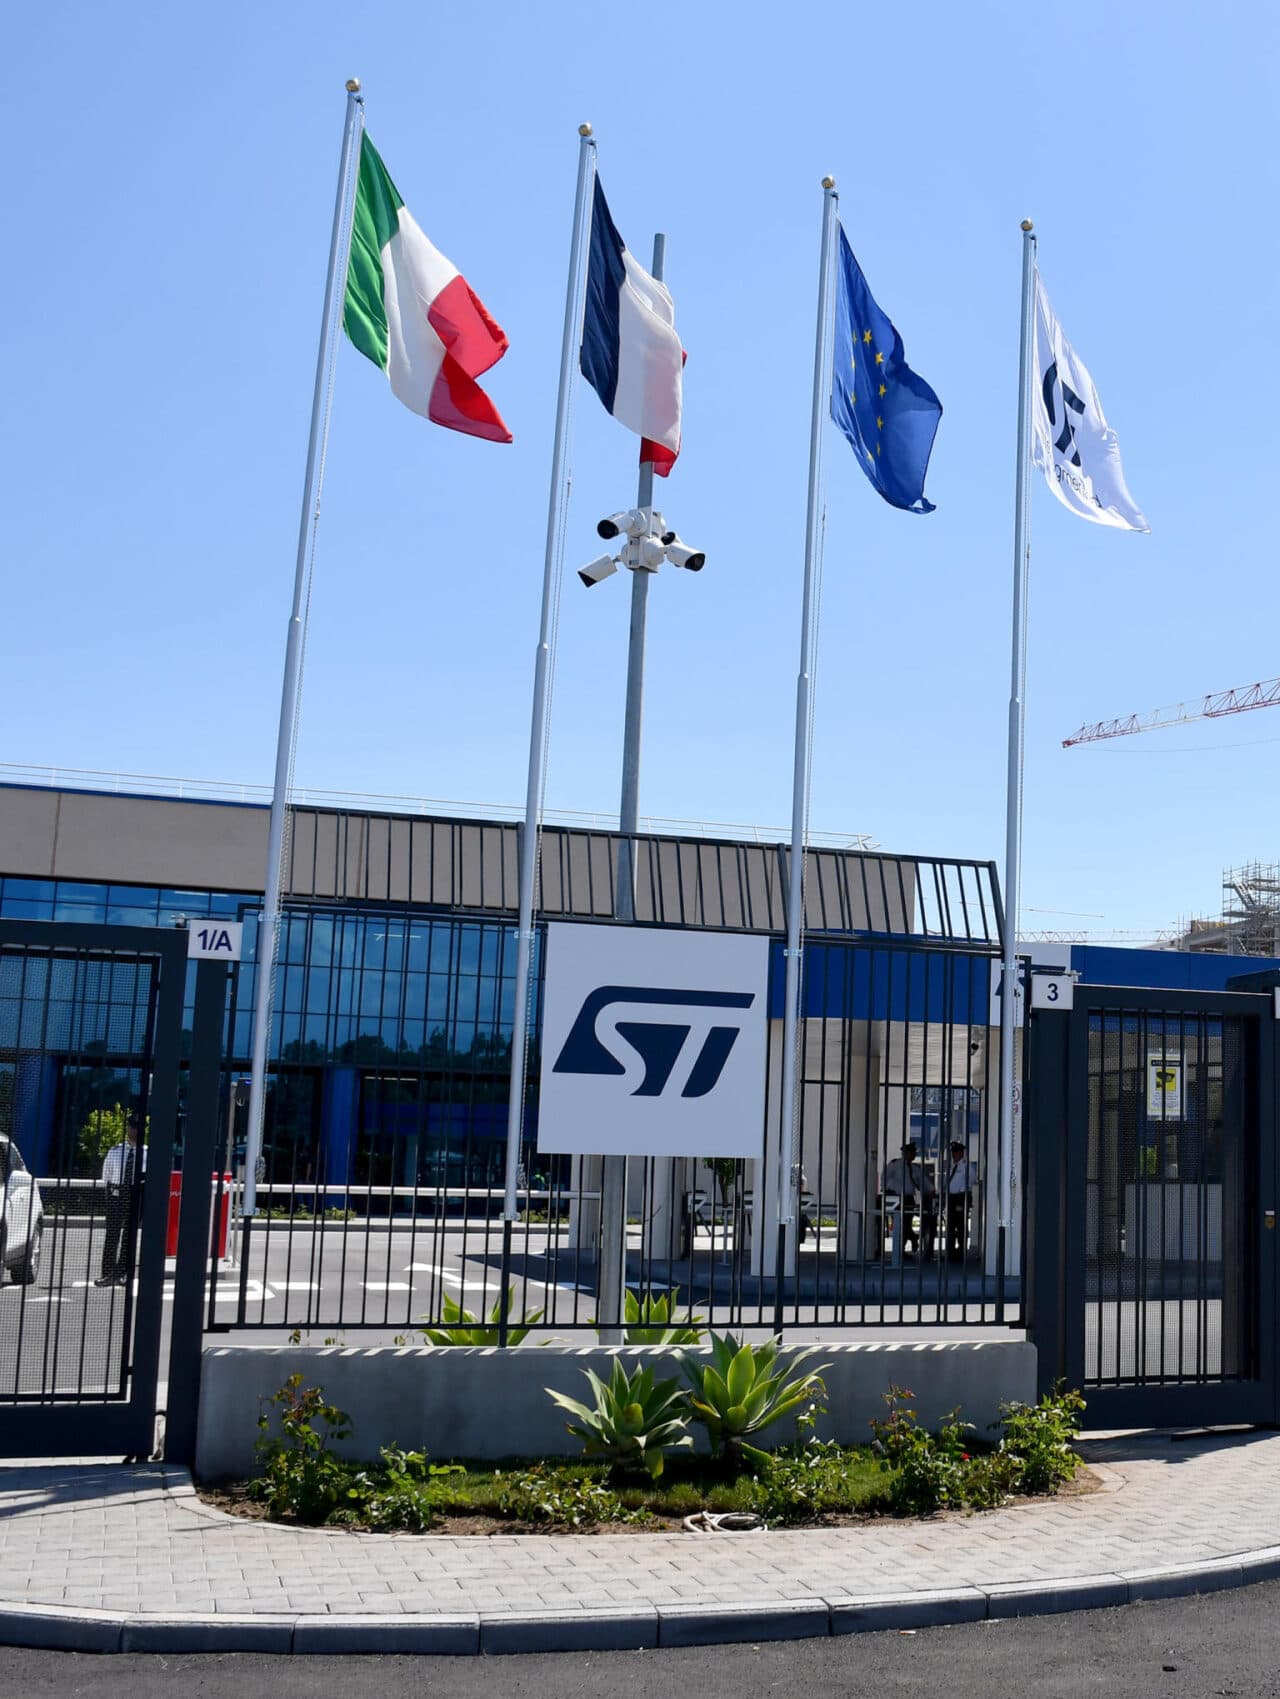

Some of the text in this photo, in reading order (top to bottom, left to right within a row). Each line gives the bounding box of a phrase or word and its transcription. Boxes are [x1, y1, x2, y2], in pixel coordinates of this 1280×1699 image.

[197, 928, 233, 952] 1/A
[1047, 983, 1059, 1002] 3
[552, 985, 756, 1098] ST
